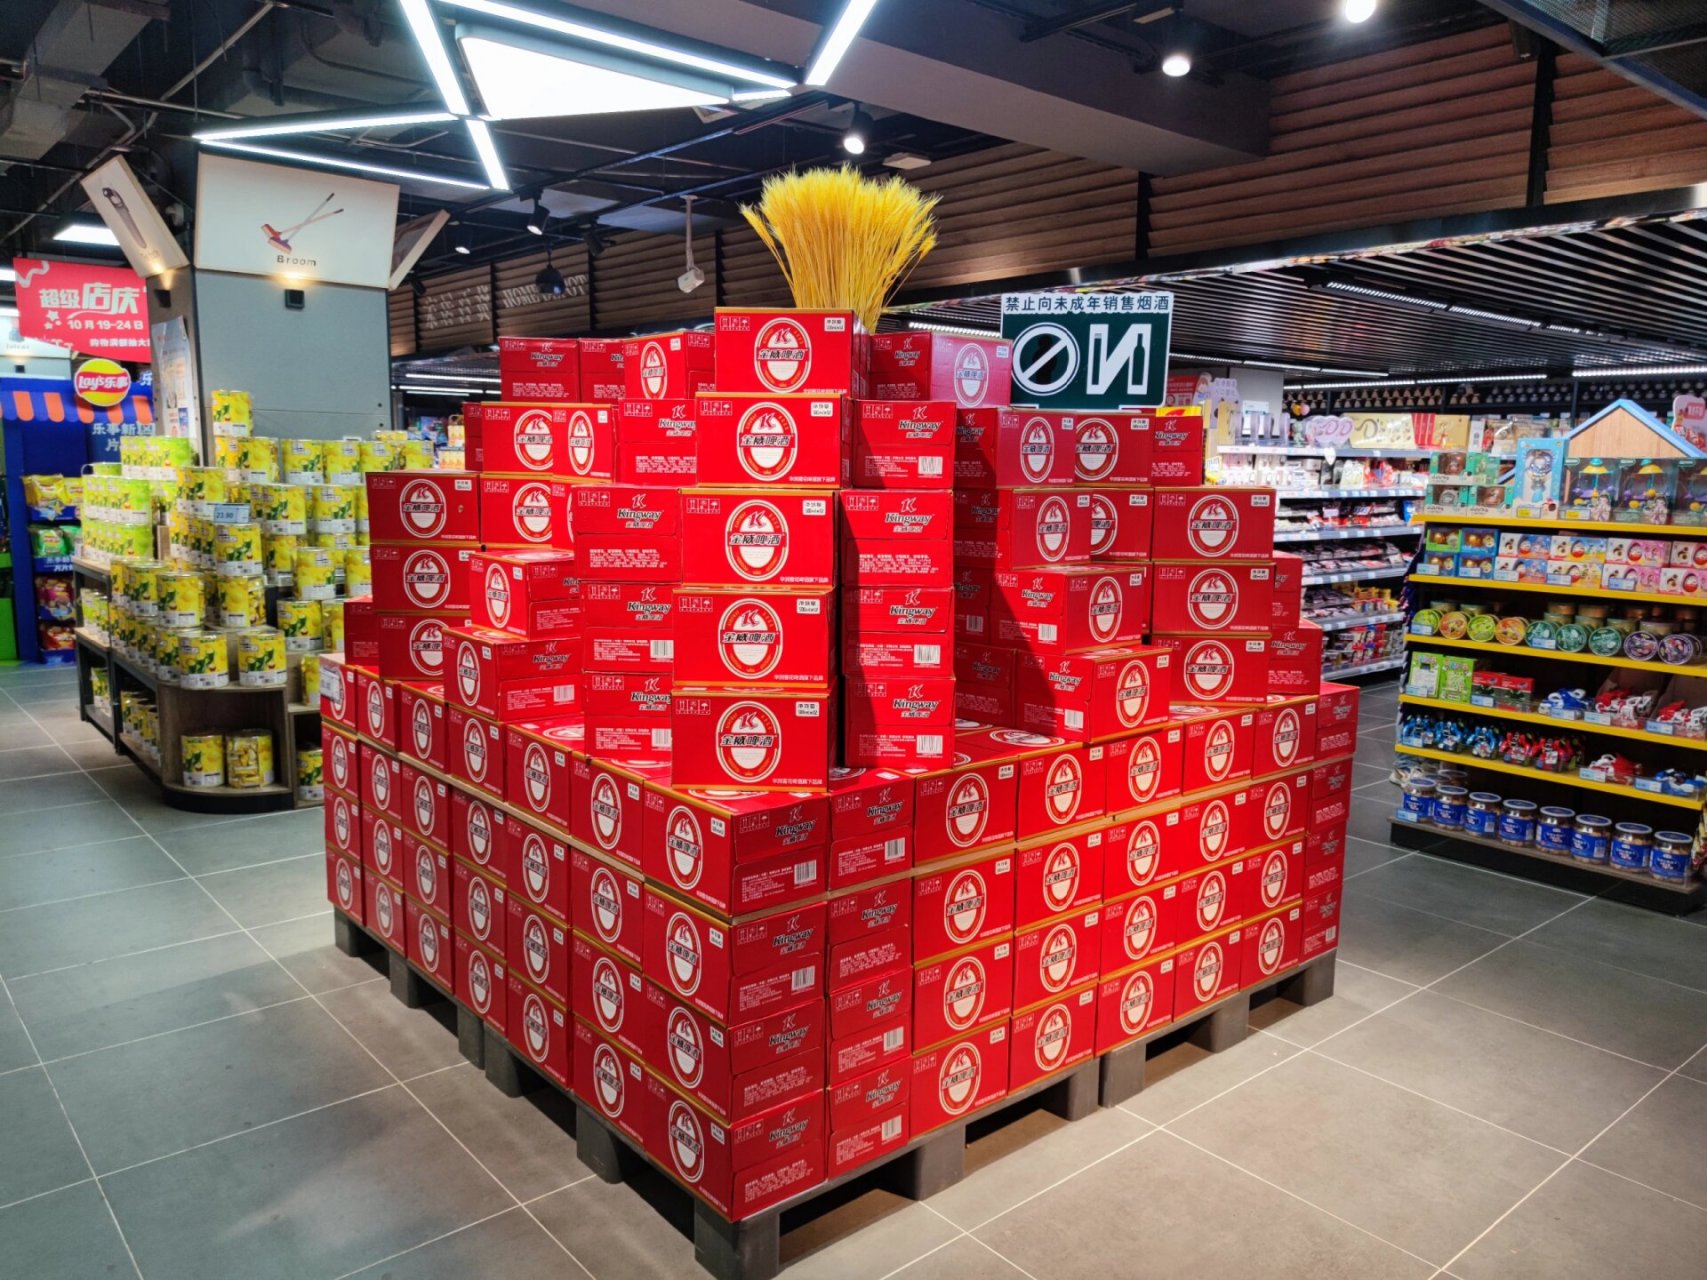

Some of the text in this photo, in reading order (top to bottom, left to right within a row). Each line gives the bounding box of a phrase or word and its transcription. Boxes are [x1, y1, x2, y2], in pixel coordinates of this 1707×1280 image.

[276, 254, 317, 267] Broom
[40, 282, 140, 314] 超级店庆
[1005, 295, 1169, 311] 禁止向未成年销售烟酒
[530, 352, 564, 362] Kingway
[759, 349, 805, 360] 金威啤酒
[105, 376, 129, 388] 乐事
[899, 419, 942, 431] Kingway
[742, 435, 791, 446] 金威啤酒
[404, 503, 442, 513] 金威啤酒
[617, 509, 663, 522] Kingway
[884, 512, 932, 525] Kingway
[1191, 519, 1234, 530] 金威啤酒
[730, 533, 781, 545] 金威啤酒
[406, 573, 446, 583] 金威啤酒
[1022, 590, 1055, 601] Kingway
[1191, 592, 1234, 603] 金威啤酒
[627, 602, 671, 614] Kingway
[889, 605, 936, 617] Kingway
[723, 632, 776, 643] 金威啤酒
[414, 641, 443, 651] 金威啤
[532, 654, 569, 664] Kingway
[1187, 663, 1229, 674] 金威啤酒
[1049, 673, 1082, 685] Kingway
[893, 698, 939, 712] Kingway
[720, 735, 775, 747] 金威啤酒
[1050, 780, 1078, 796] 金威啤酒
[867, 800, 903, 816] Kingway
[949, 800, 983, 818] 金威啤酒
[776, 820, 816, 837] Kingway
[669, 837, 698, 857] 金威啤酒
[1047, 868, 1076, 883] 金威啤酒
[861, 903, 898, 920] Kingway
[947, 896, 982, 915] 金威啤酒
[772, 927, 813, 947] Kingway
[669, 943, 698, 962] 金威啤酒
[1044, 948, 1074, 966] 金威啤酒
[947, 982, 981, 1001] 金威啤酒
[1039, 1027, 1069, 1044] 金威啤酒
[669, 1034, 700, 1057] 金威啤酒
[943, 1067, 977, 1088] 金威啤酒
[671, 1127, 701, 1154] 金威啤酒
